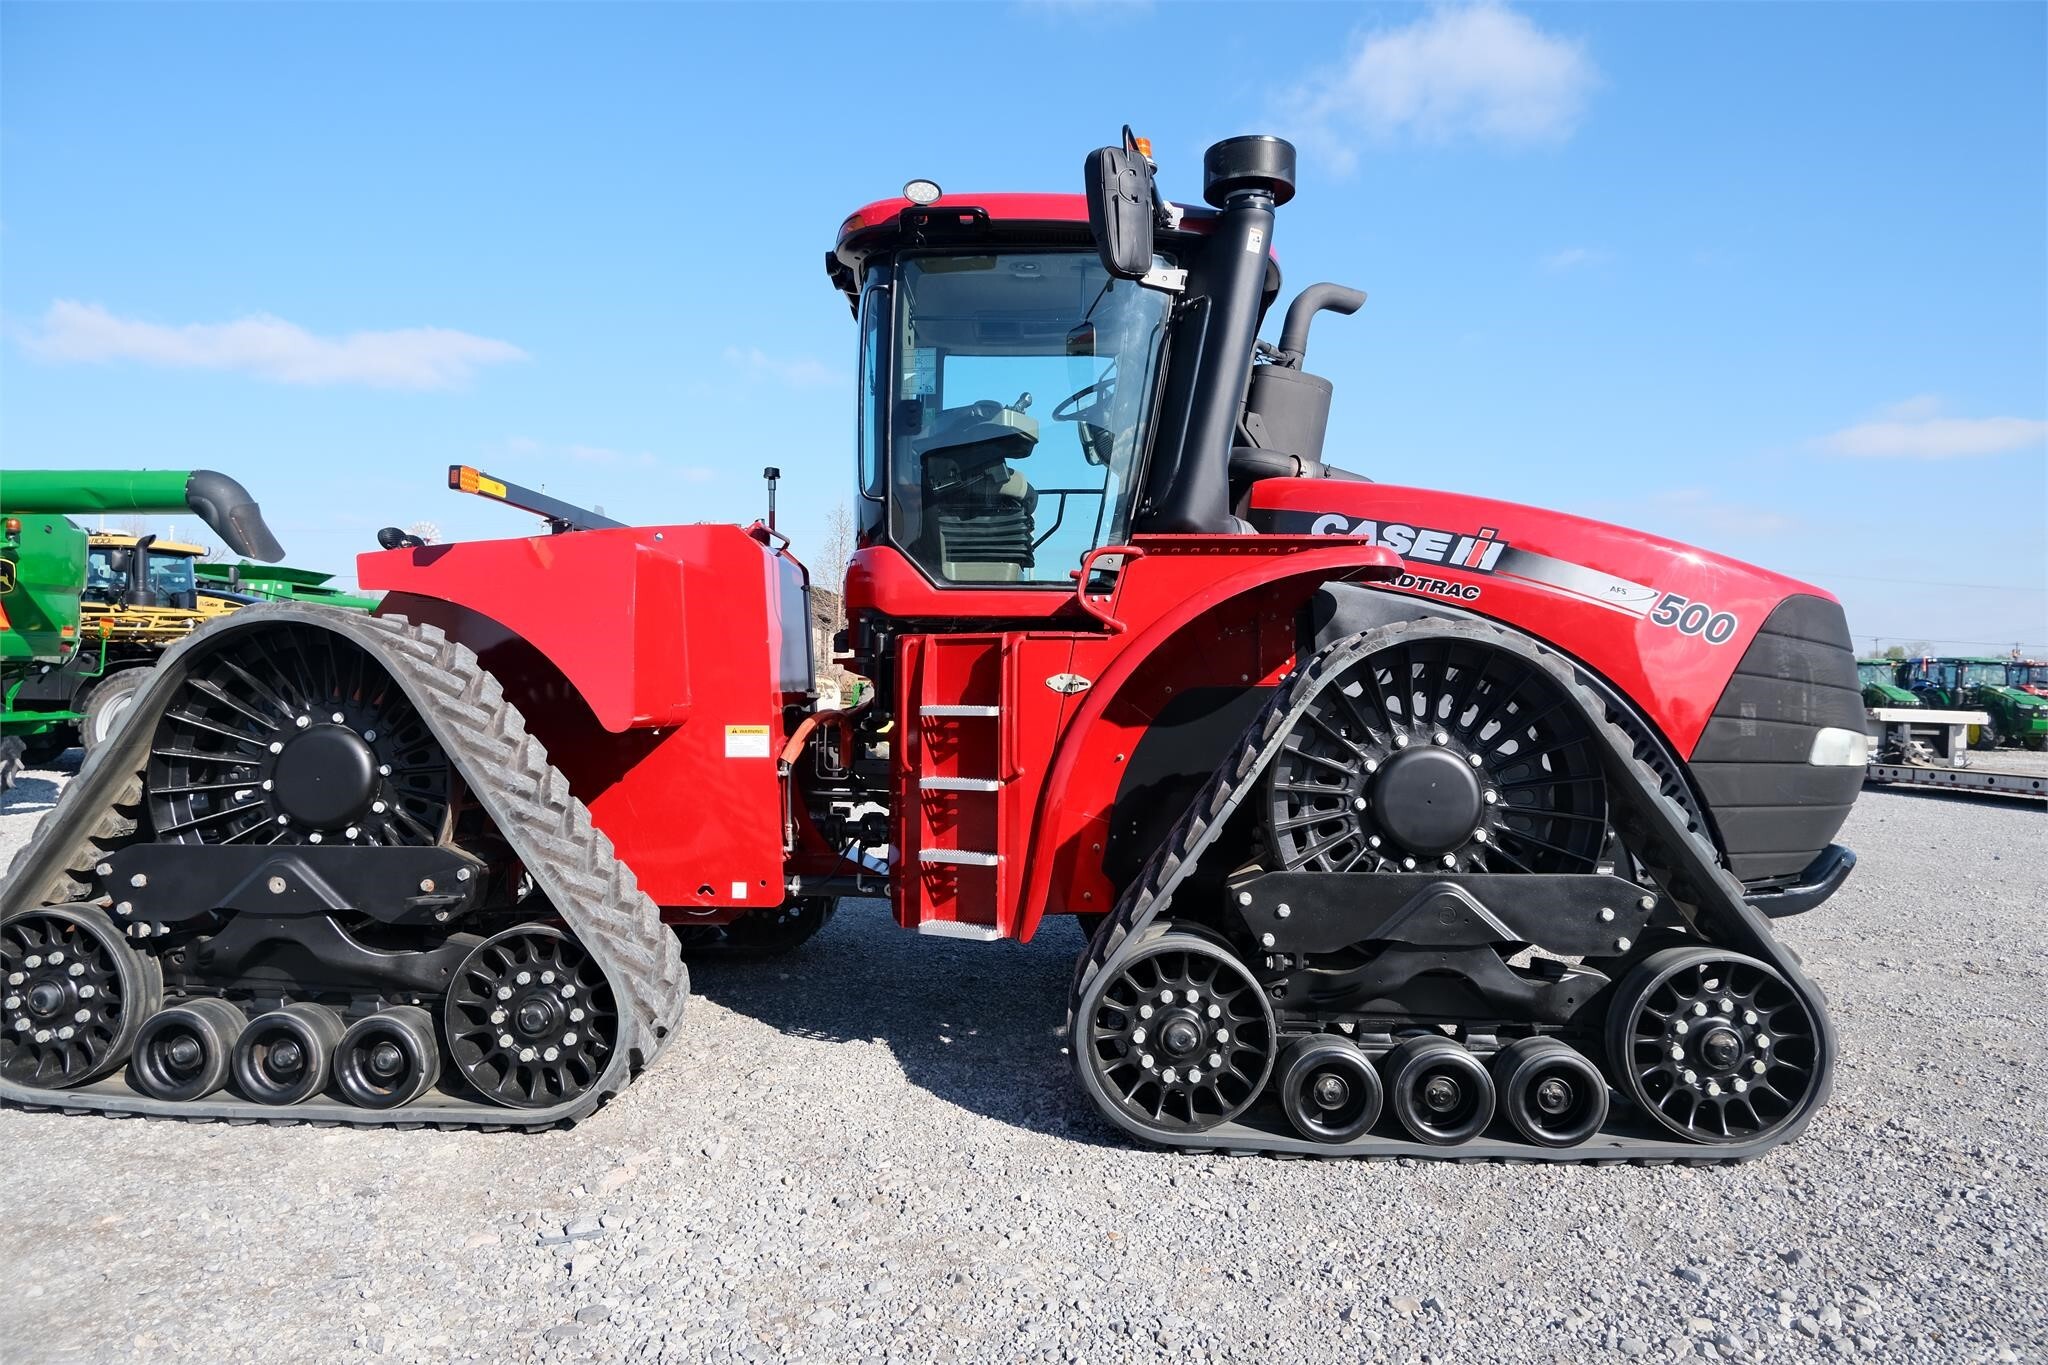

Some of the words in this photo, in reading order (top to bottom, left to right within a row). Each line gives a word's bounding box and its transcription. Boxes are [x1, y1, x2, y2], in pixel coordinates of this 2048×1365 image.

[1311, 514, 1453, 561] CASE
[1380, 573, 1480, 600] ADTRAC
[1609, 585, 1627, 595] AFS
[1650, 592, 1738, 645] 500
